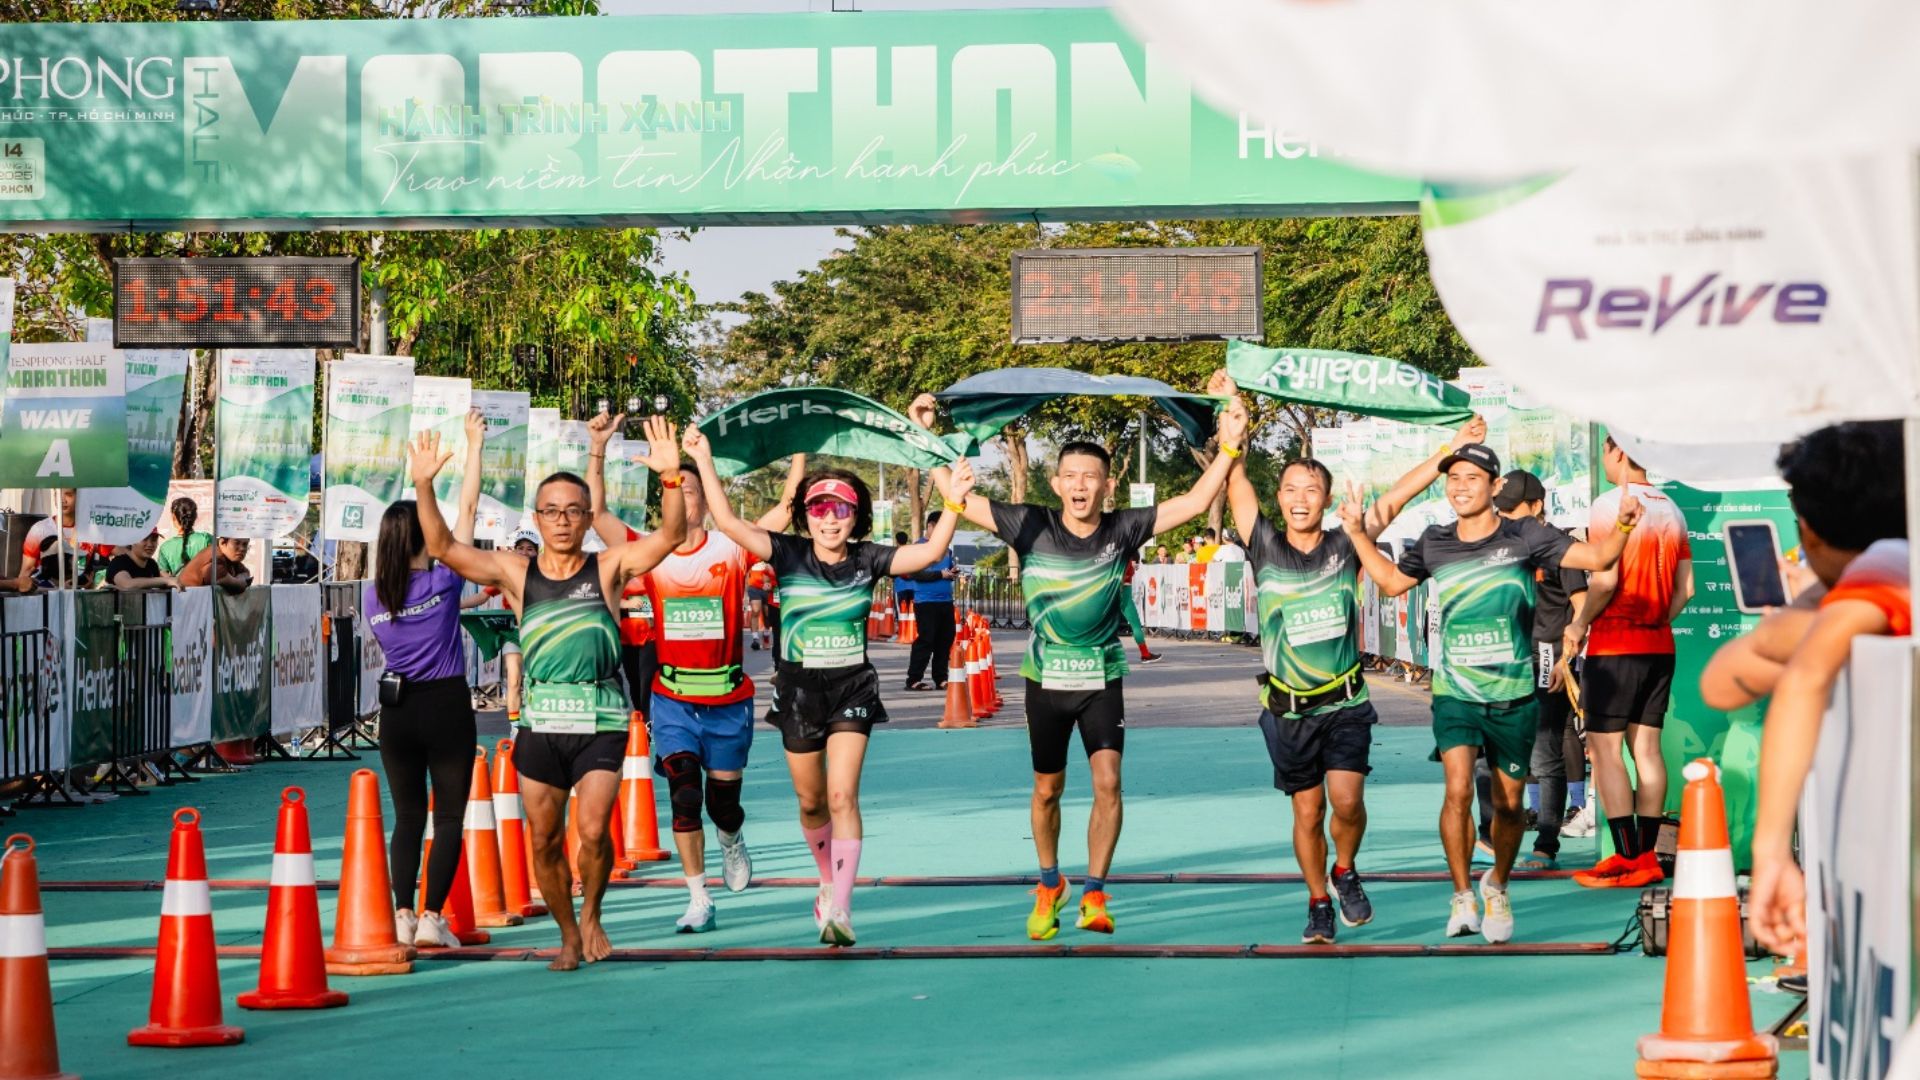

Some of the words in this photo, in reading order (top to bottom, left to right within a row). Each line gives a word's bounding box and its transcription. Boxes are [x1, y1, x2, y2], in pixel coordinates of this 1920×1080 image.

[49, 111, 74, 120] TP.
[135, 111, 175, 120] MINH
[183, 42, 1191, 200] MARATHON
[193, 67, 220, 184] HALF
[620, 101, 732, 136] XANH
[4, 143, 24, 157] 14
[374, 140, 483, 205] Trao
[954, 131, 1083, 206] phúc
[121, 278, 336, 322] 1:51:43
[1022, 271, 1243, 314] 2:11:48
[1534, 272, 1830, 341] ReVive
[75, 355, 107, 366] HALF
[7, 368, 108, 388] MARATHON
[1273, 354, 1444, 400] Herbalife
[20, 409, 92, 430] WAVE
[35, 439, 75, 477] A
[89, 510, 145, 528] Herbalife
[672, 610, 714, 622] 21939
[1293, 606, 1336, 625] 21962
[814, 635, 856, 648] 21026
[1458, 631, 1500, 646] 21951
[1053, 659, 1095, 671] 21969
[1542, 649, 1550, 685] MEDIA
[542, 698, 585, 712] 21832
